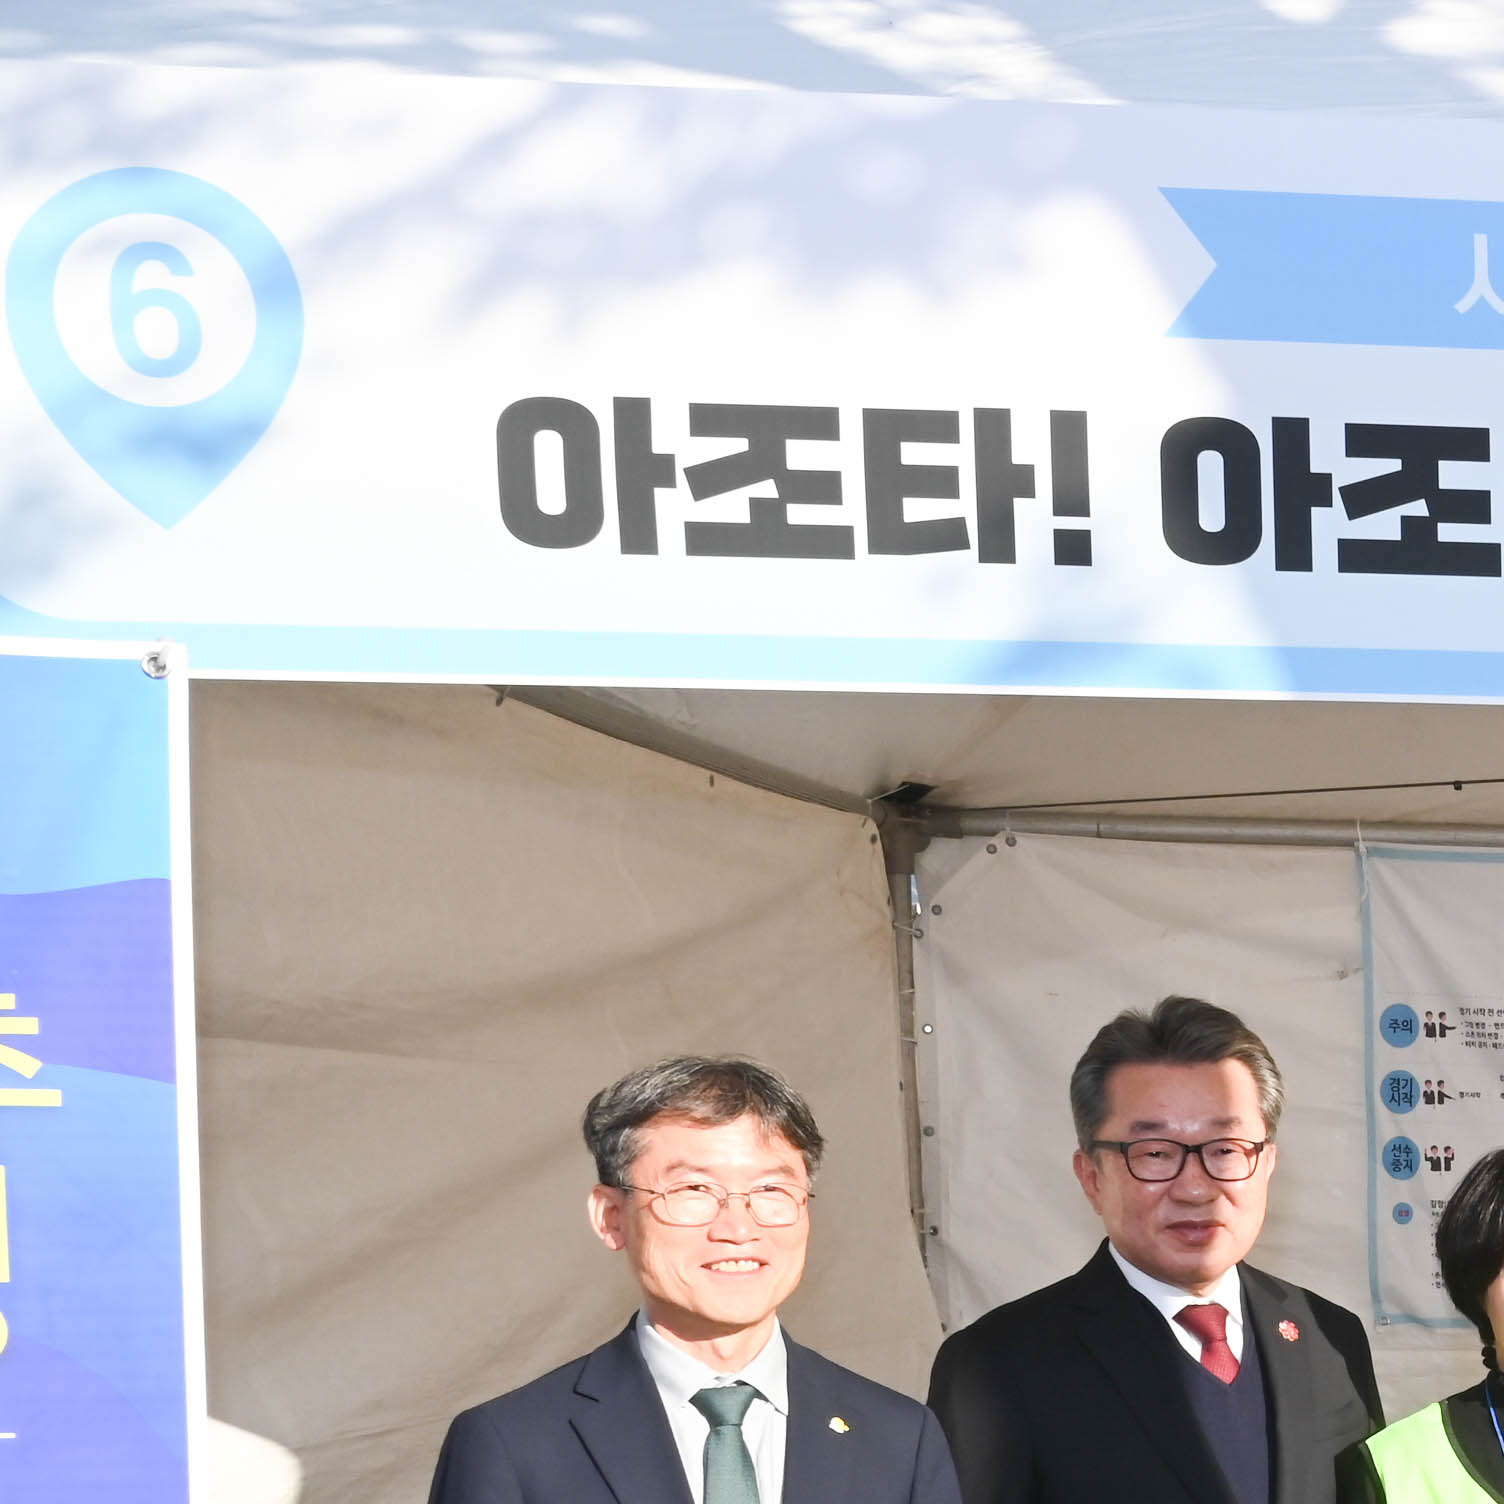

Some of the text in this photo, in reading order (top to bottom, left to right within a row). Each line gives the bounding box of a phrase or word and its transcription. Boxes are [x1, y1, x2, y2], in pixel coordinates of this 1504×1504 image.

[107, 241, 202, 379] 6
[495, 396, 1092, 568] 아조타!
[1388, 1019, 1413, 1034] 주의
[1389, 1078, 1413, 1093] 경기
[1389, 1093, 1414, 1107] 시작
[1391, 1144, 1413, 1158] 선수
[1391, 1159, 1413, 1173] 중지
